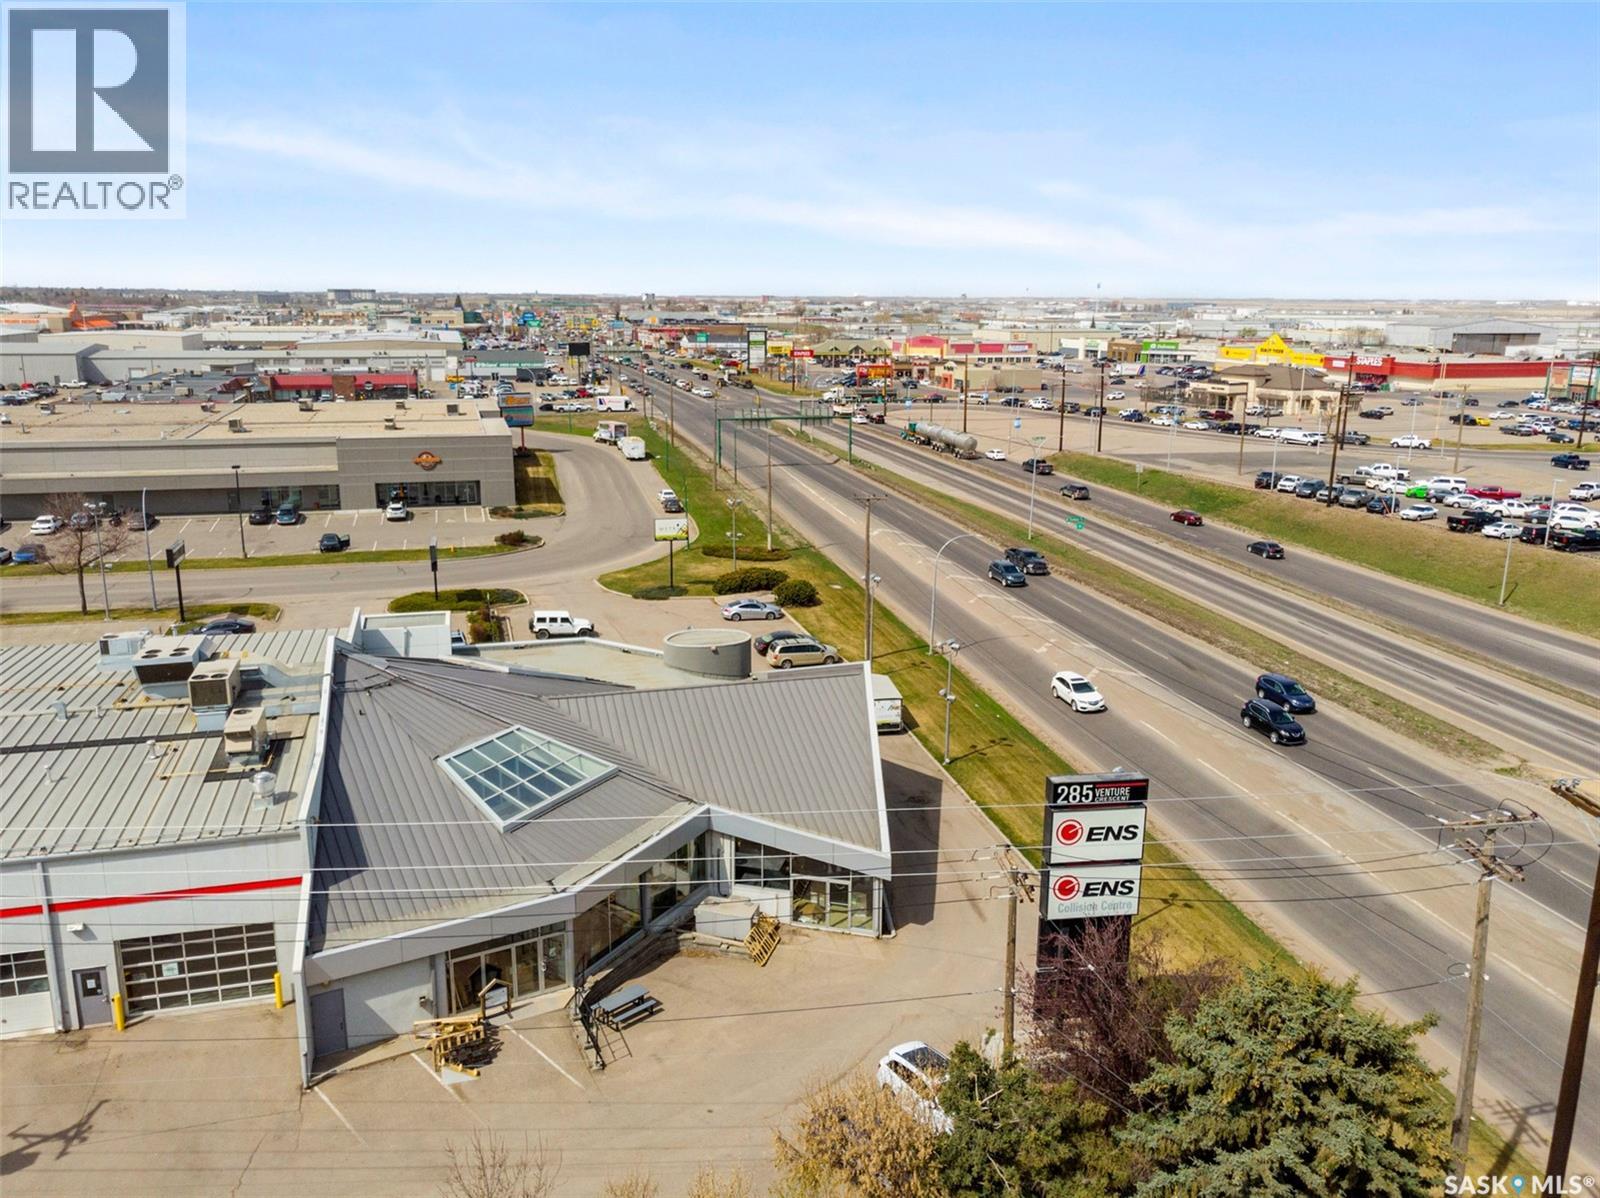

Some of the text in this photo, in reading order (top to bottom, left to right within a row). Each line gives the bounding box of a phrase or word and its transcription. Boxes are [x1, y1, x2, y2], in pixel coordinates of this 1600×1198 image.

[1057, 784, 1093, 804] 285
[1095, 787, 1130, 796] VENTURE
[1086, 824, 1139, 842] ENS
[1082, 880, 1135, 898] ENS
[1057, 903, 1098, 914] Collision
